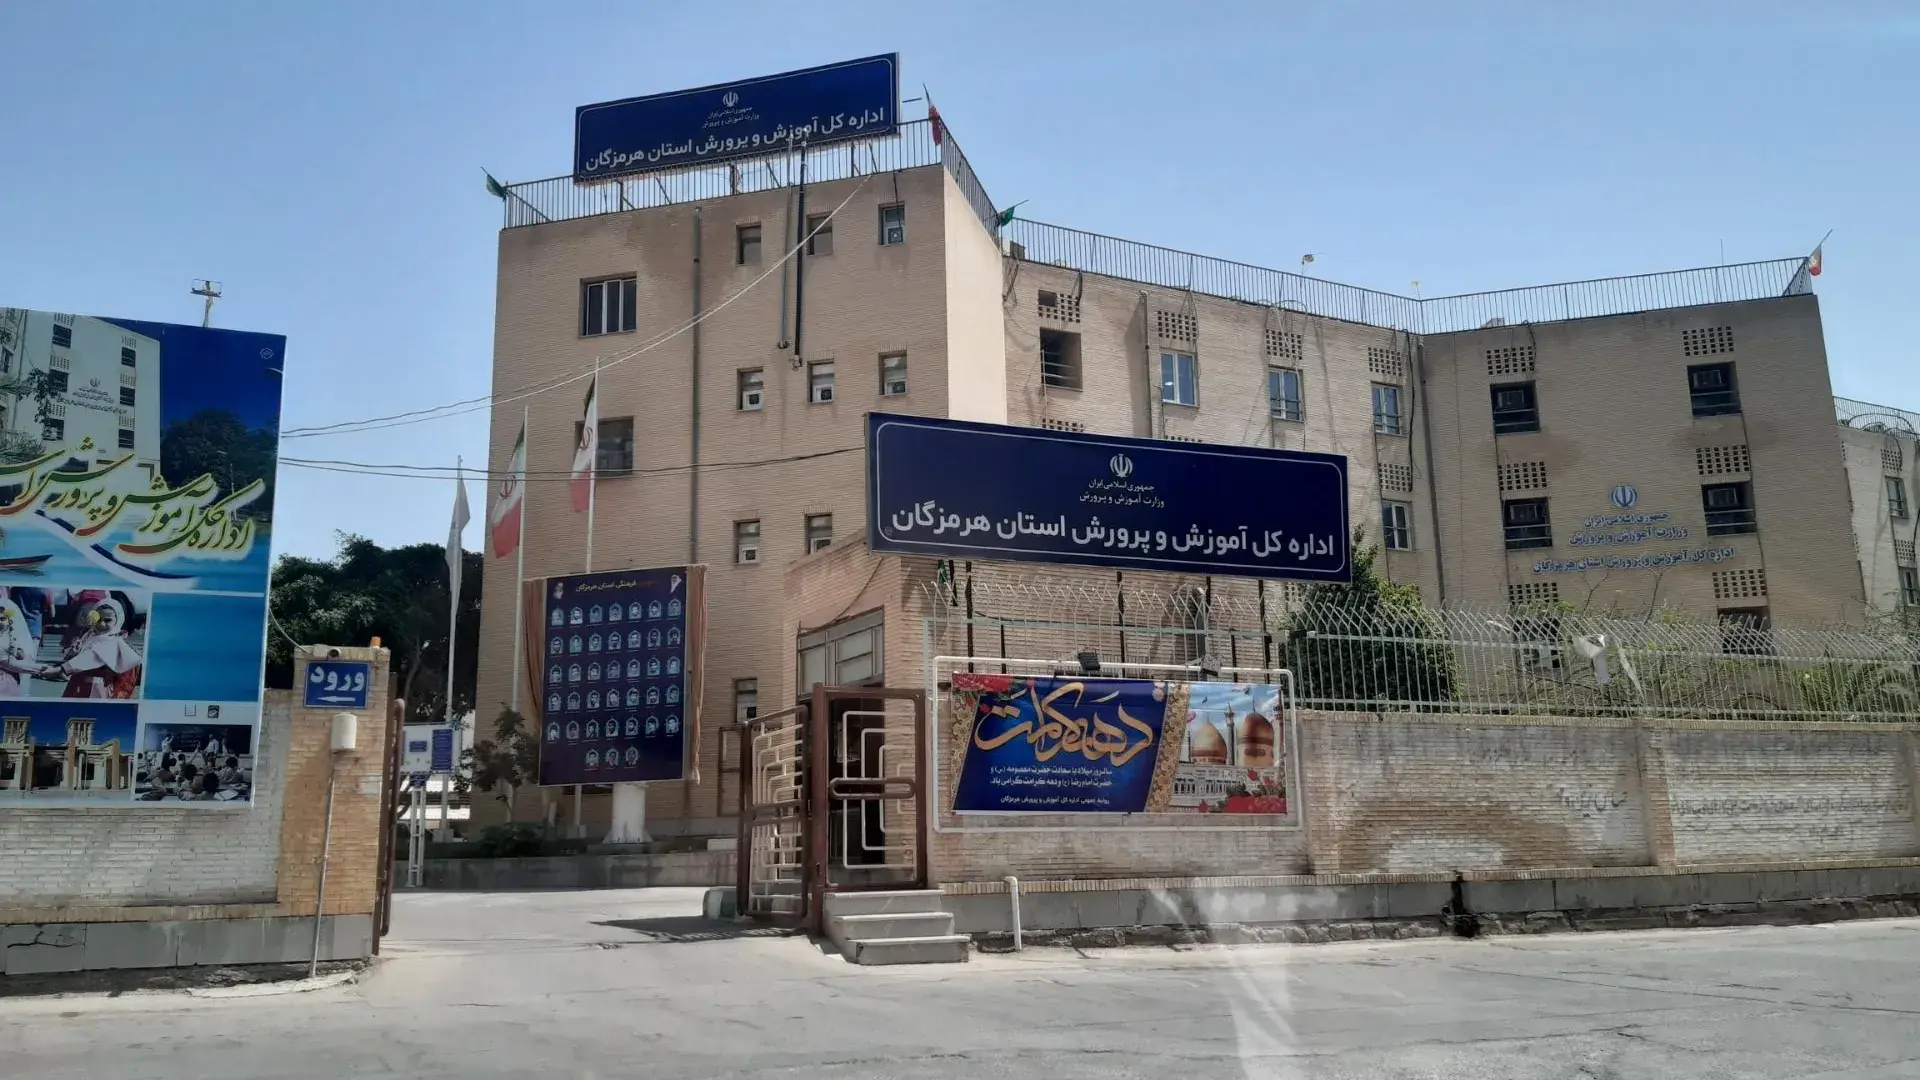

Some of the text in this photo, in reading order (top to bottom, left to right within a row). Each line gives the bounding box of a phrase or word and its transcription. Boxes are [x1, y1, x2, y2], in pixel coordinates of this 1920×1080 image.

[585, 107, 884, 171] اداره کل آموزش و پرورش استان هرمزگان
[1088, 478, 1155, 493] جمهوری اسلامی ایران
[1079, 491, 1165, 508] وزارت آموزش و پرورش
[1584, 512, 1669, 528] جمهوری اسلامی ایران
[892, 500, 1334, 561] اداره کل آموزش و پرورش استان هرمزگان
[1569, 524, 1689, 546] وزارت آموزش و پرورش
[1652, 549, 1688, 566] آموزش
[1692, 549, 1708, 562] کل
[1709, 547, 1735, 562] اداره
[1532, 559, 1576, 573] هرمزگان
[1578, 557, 1605, 571] استان
[575, 583, 598, 592] هرمزگان
[598, 582, 614, 590] استان
[310, 666, 365, 692] ورود
[1006, 766, 1031, 775] معصومه
[1031, 765, 1051, 775] حضرت
[1052, 766, 1071, 775] سعادت
[1000, 775, 1023, 787] گرامی
[1022, 776, 1046, 787] کرامت
[1070, 777, 1081, 788] رضا
[1081, 778, 1093, 788] امام
[1093, 778, 1113, 788] حضرت
